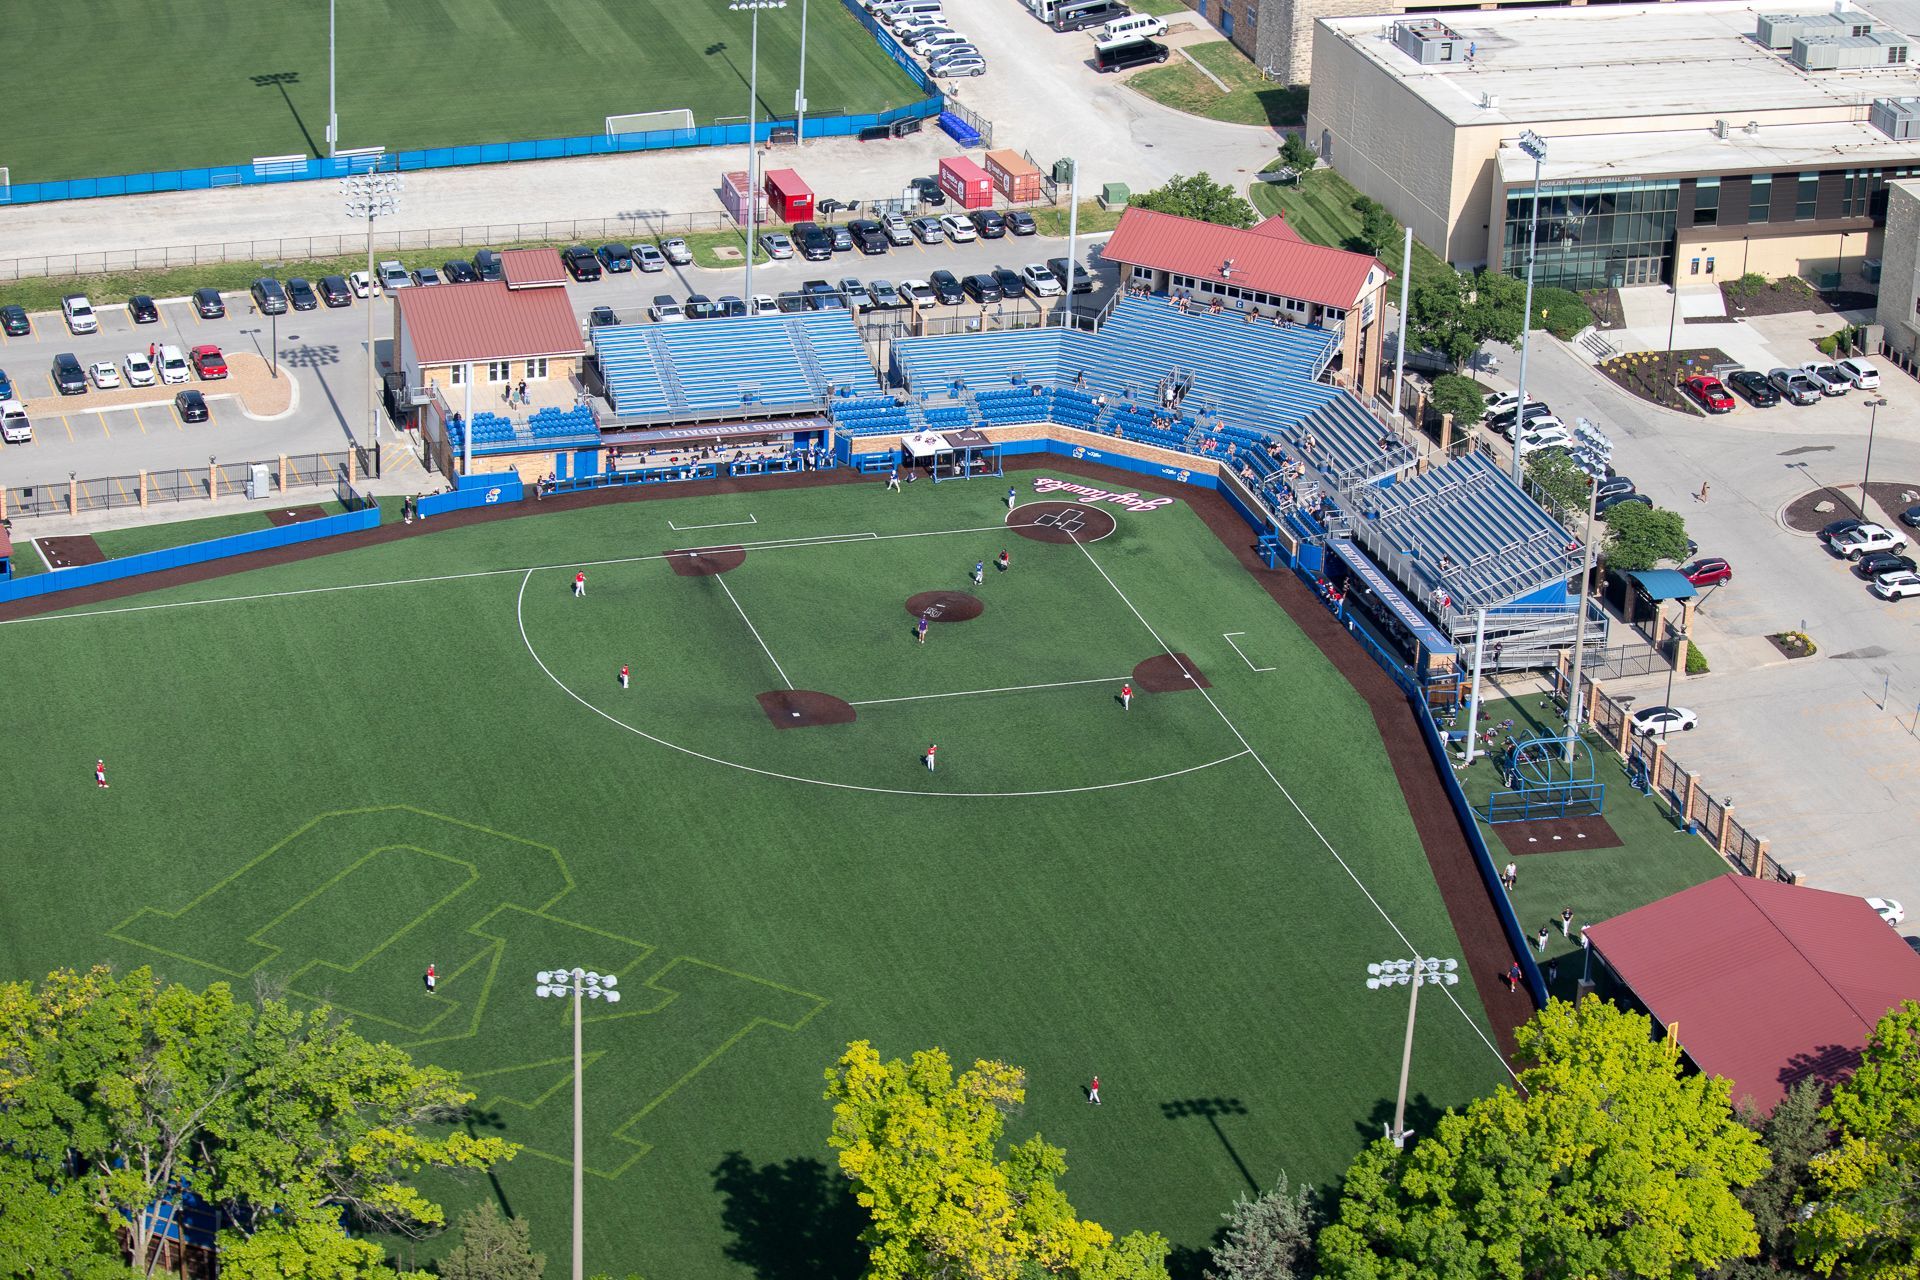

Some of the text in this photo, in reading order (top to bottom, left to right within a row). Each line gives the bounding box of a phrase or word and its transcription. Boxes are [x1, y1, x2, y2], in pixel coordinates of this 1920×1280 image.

[669, 425, 748, 437] BASEBALL
[753, 420, 816, 432] KANSAS
[1033, 477, 1174, 512] Jayhawks
